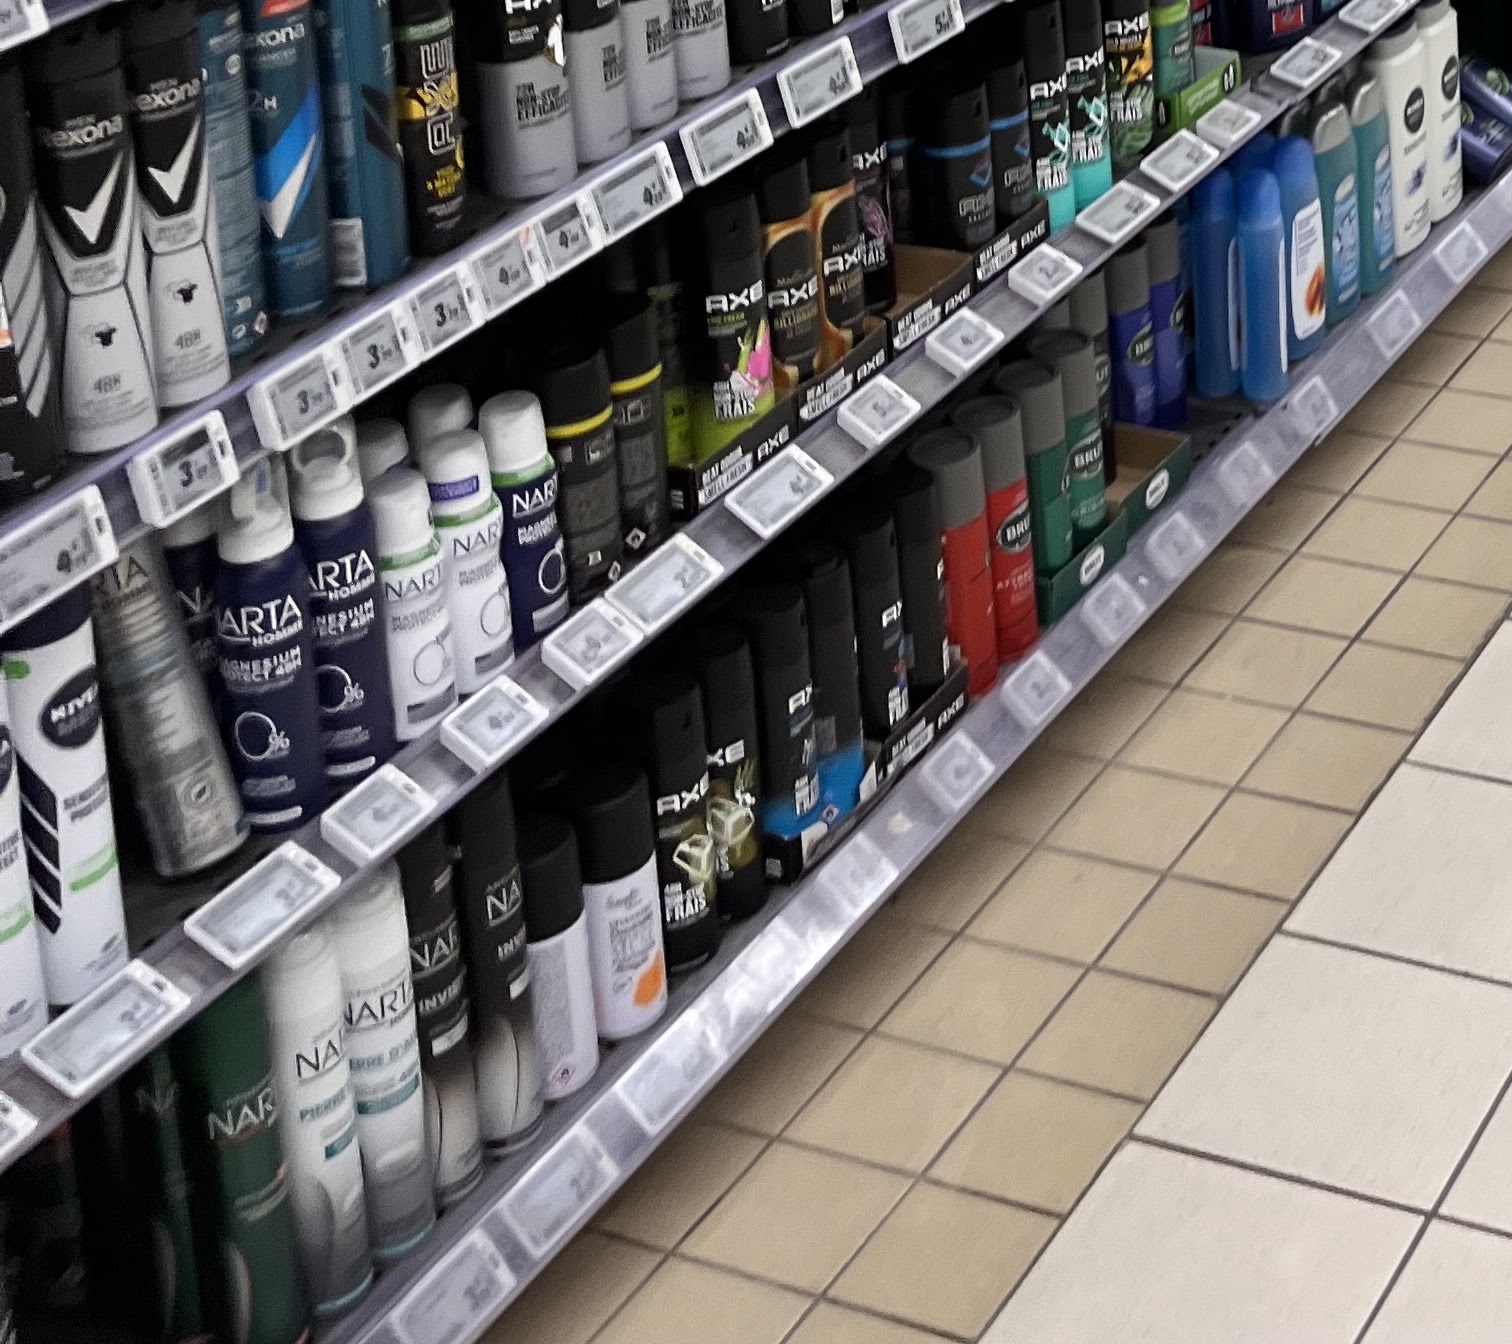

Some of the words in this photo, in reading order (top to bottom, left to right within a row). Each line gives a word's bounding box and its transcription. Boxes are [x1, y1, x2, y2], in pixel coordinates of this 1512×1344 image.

[705, 279, 763, 313] AXE
[767, 275, 819, 310] AXE
[218, 594, 303, 636] ARTA
